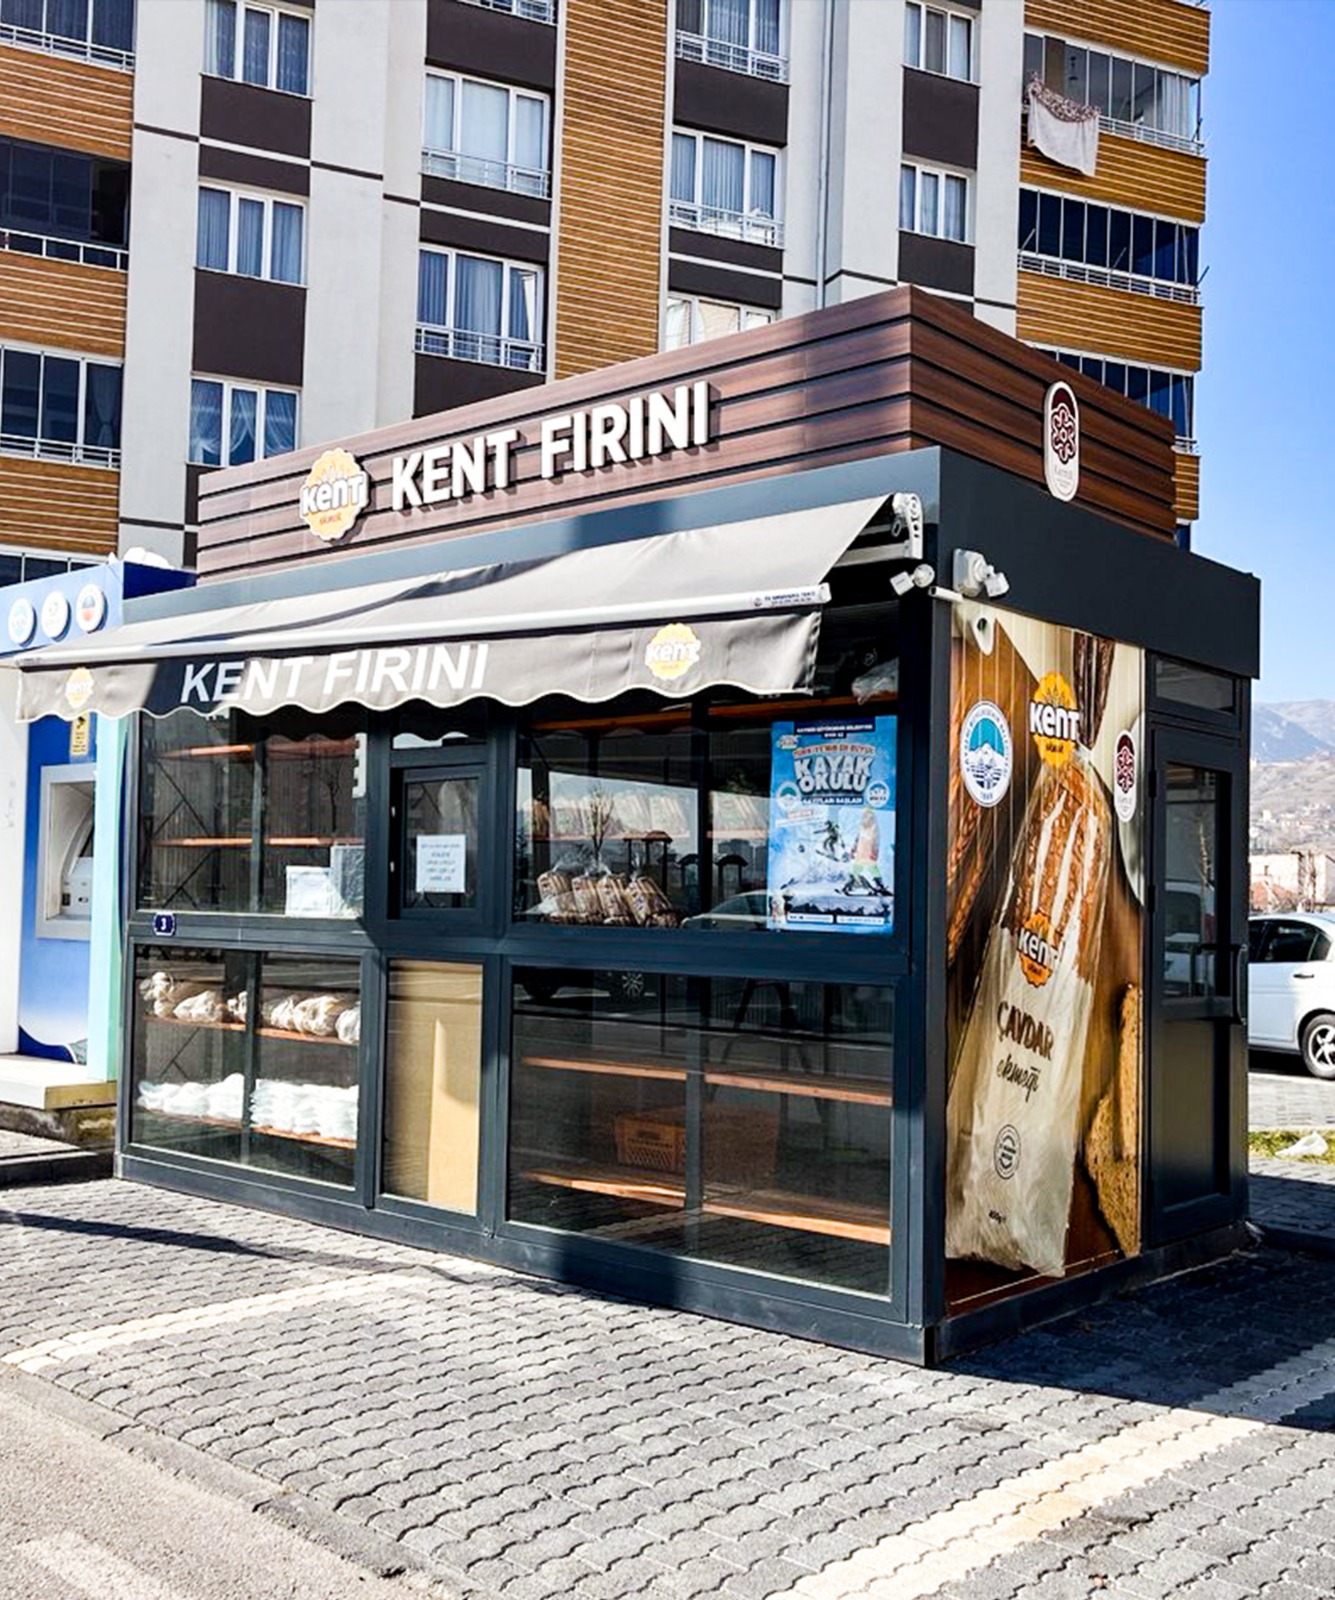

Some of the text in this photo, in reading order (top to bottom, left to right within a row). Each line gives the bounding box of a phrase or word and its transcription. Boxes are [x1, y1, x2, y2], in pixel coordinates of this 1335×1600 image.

[391, 381, 709, 511] KENT FIRINI
[180, 643, 489, 704] KENT FIRINI
[794, 756, 874, 779] KAYAK
[799, 772, 868, 793] OKULU
[996, 1001, 1055, 1061] ÇAVDAR
